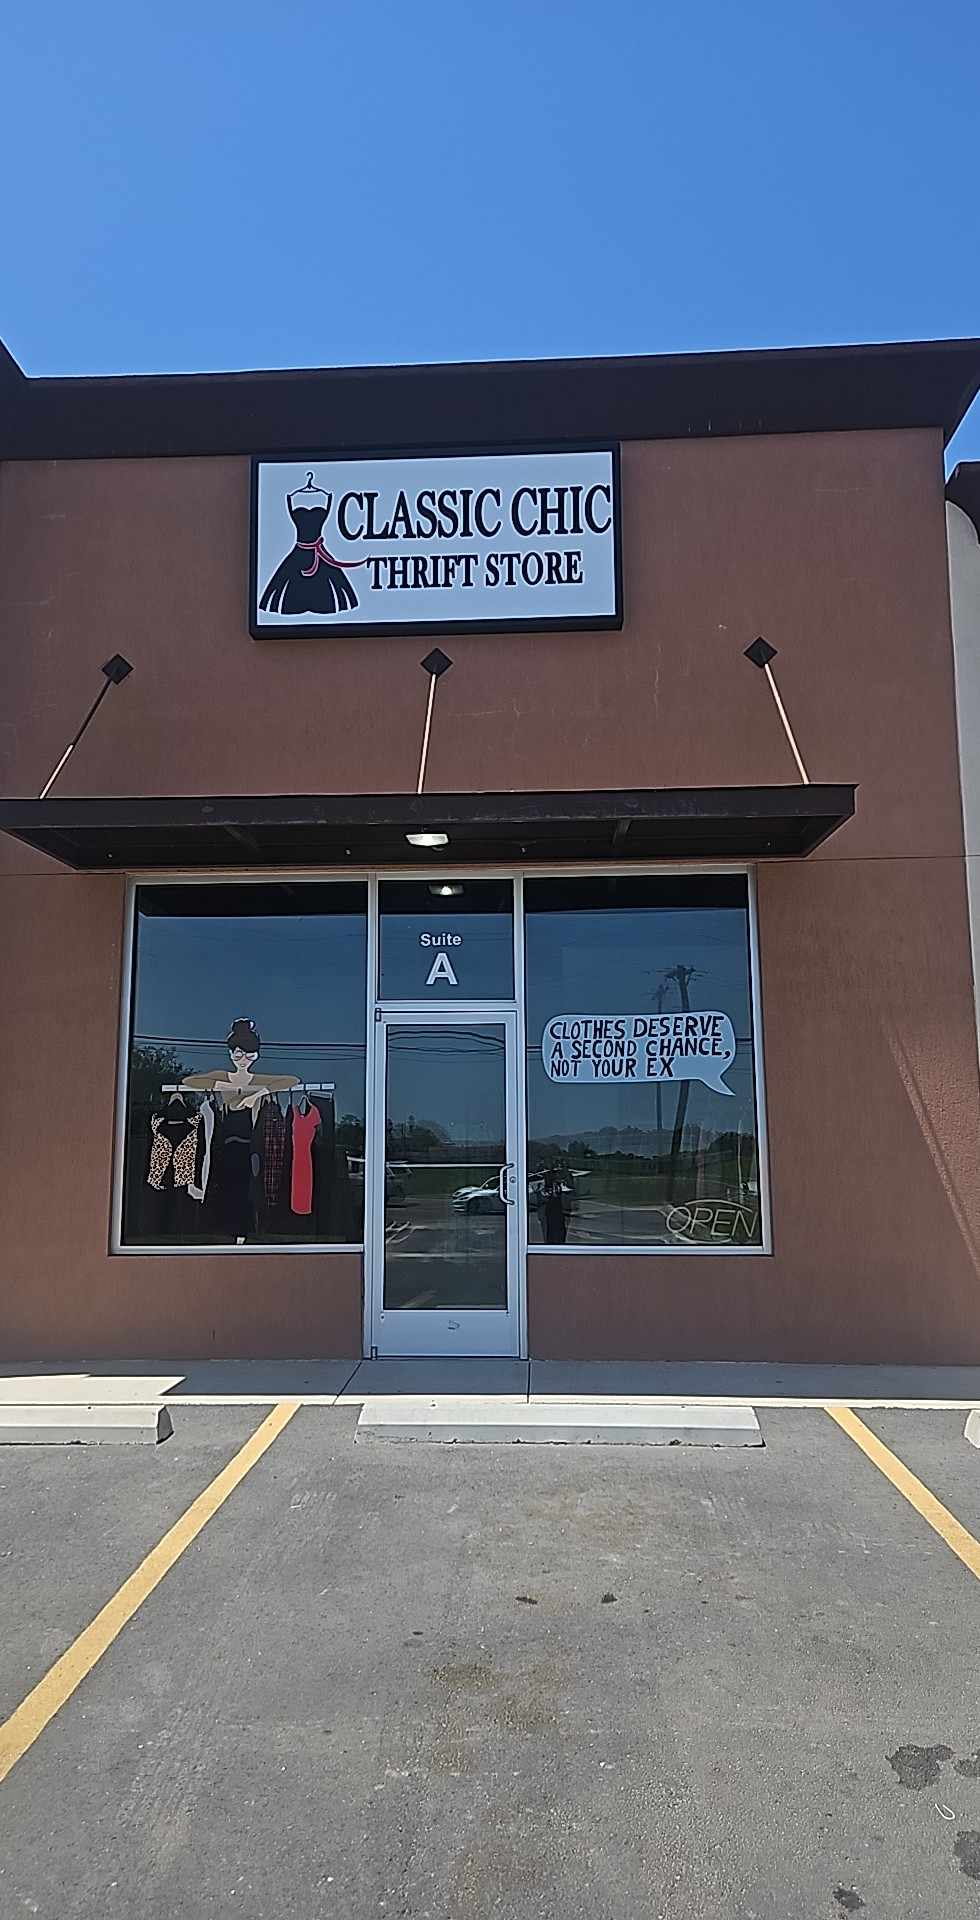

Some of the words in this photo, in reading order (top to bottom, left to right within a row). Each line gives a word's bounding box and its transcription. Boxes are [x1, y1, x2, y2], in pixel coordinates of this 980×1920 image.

[337, 488, 501, 541] CLASSIC
[511, 484, 612, 536] CHIC
[366, 553, 478, 590] THRIFT
[485, 551, 584, 586] STORE
[419, 932, 463, 947] Suite
[425, 952, 458, 985] A
[549, 1019, 626, 1040] CLOTHES
[633, 1015, 725, 1037] DESERVE
[551, 1041, 564, 1059] A
[571, 1040, 637, 1059] SECOND
[645, 1037, 732, 1059] CHANCE,
[550, 1059, 582, 1078] NOT
[591, 1058, 637, 1078] YOUR
[646, 1057, 675, 1077] EX
[665, 1206, 758, 1237] OPEN
